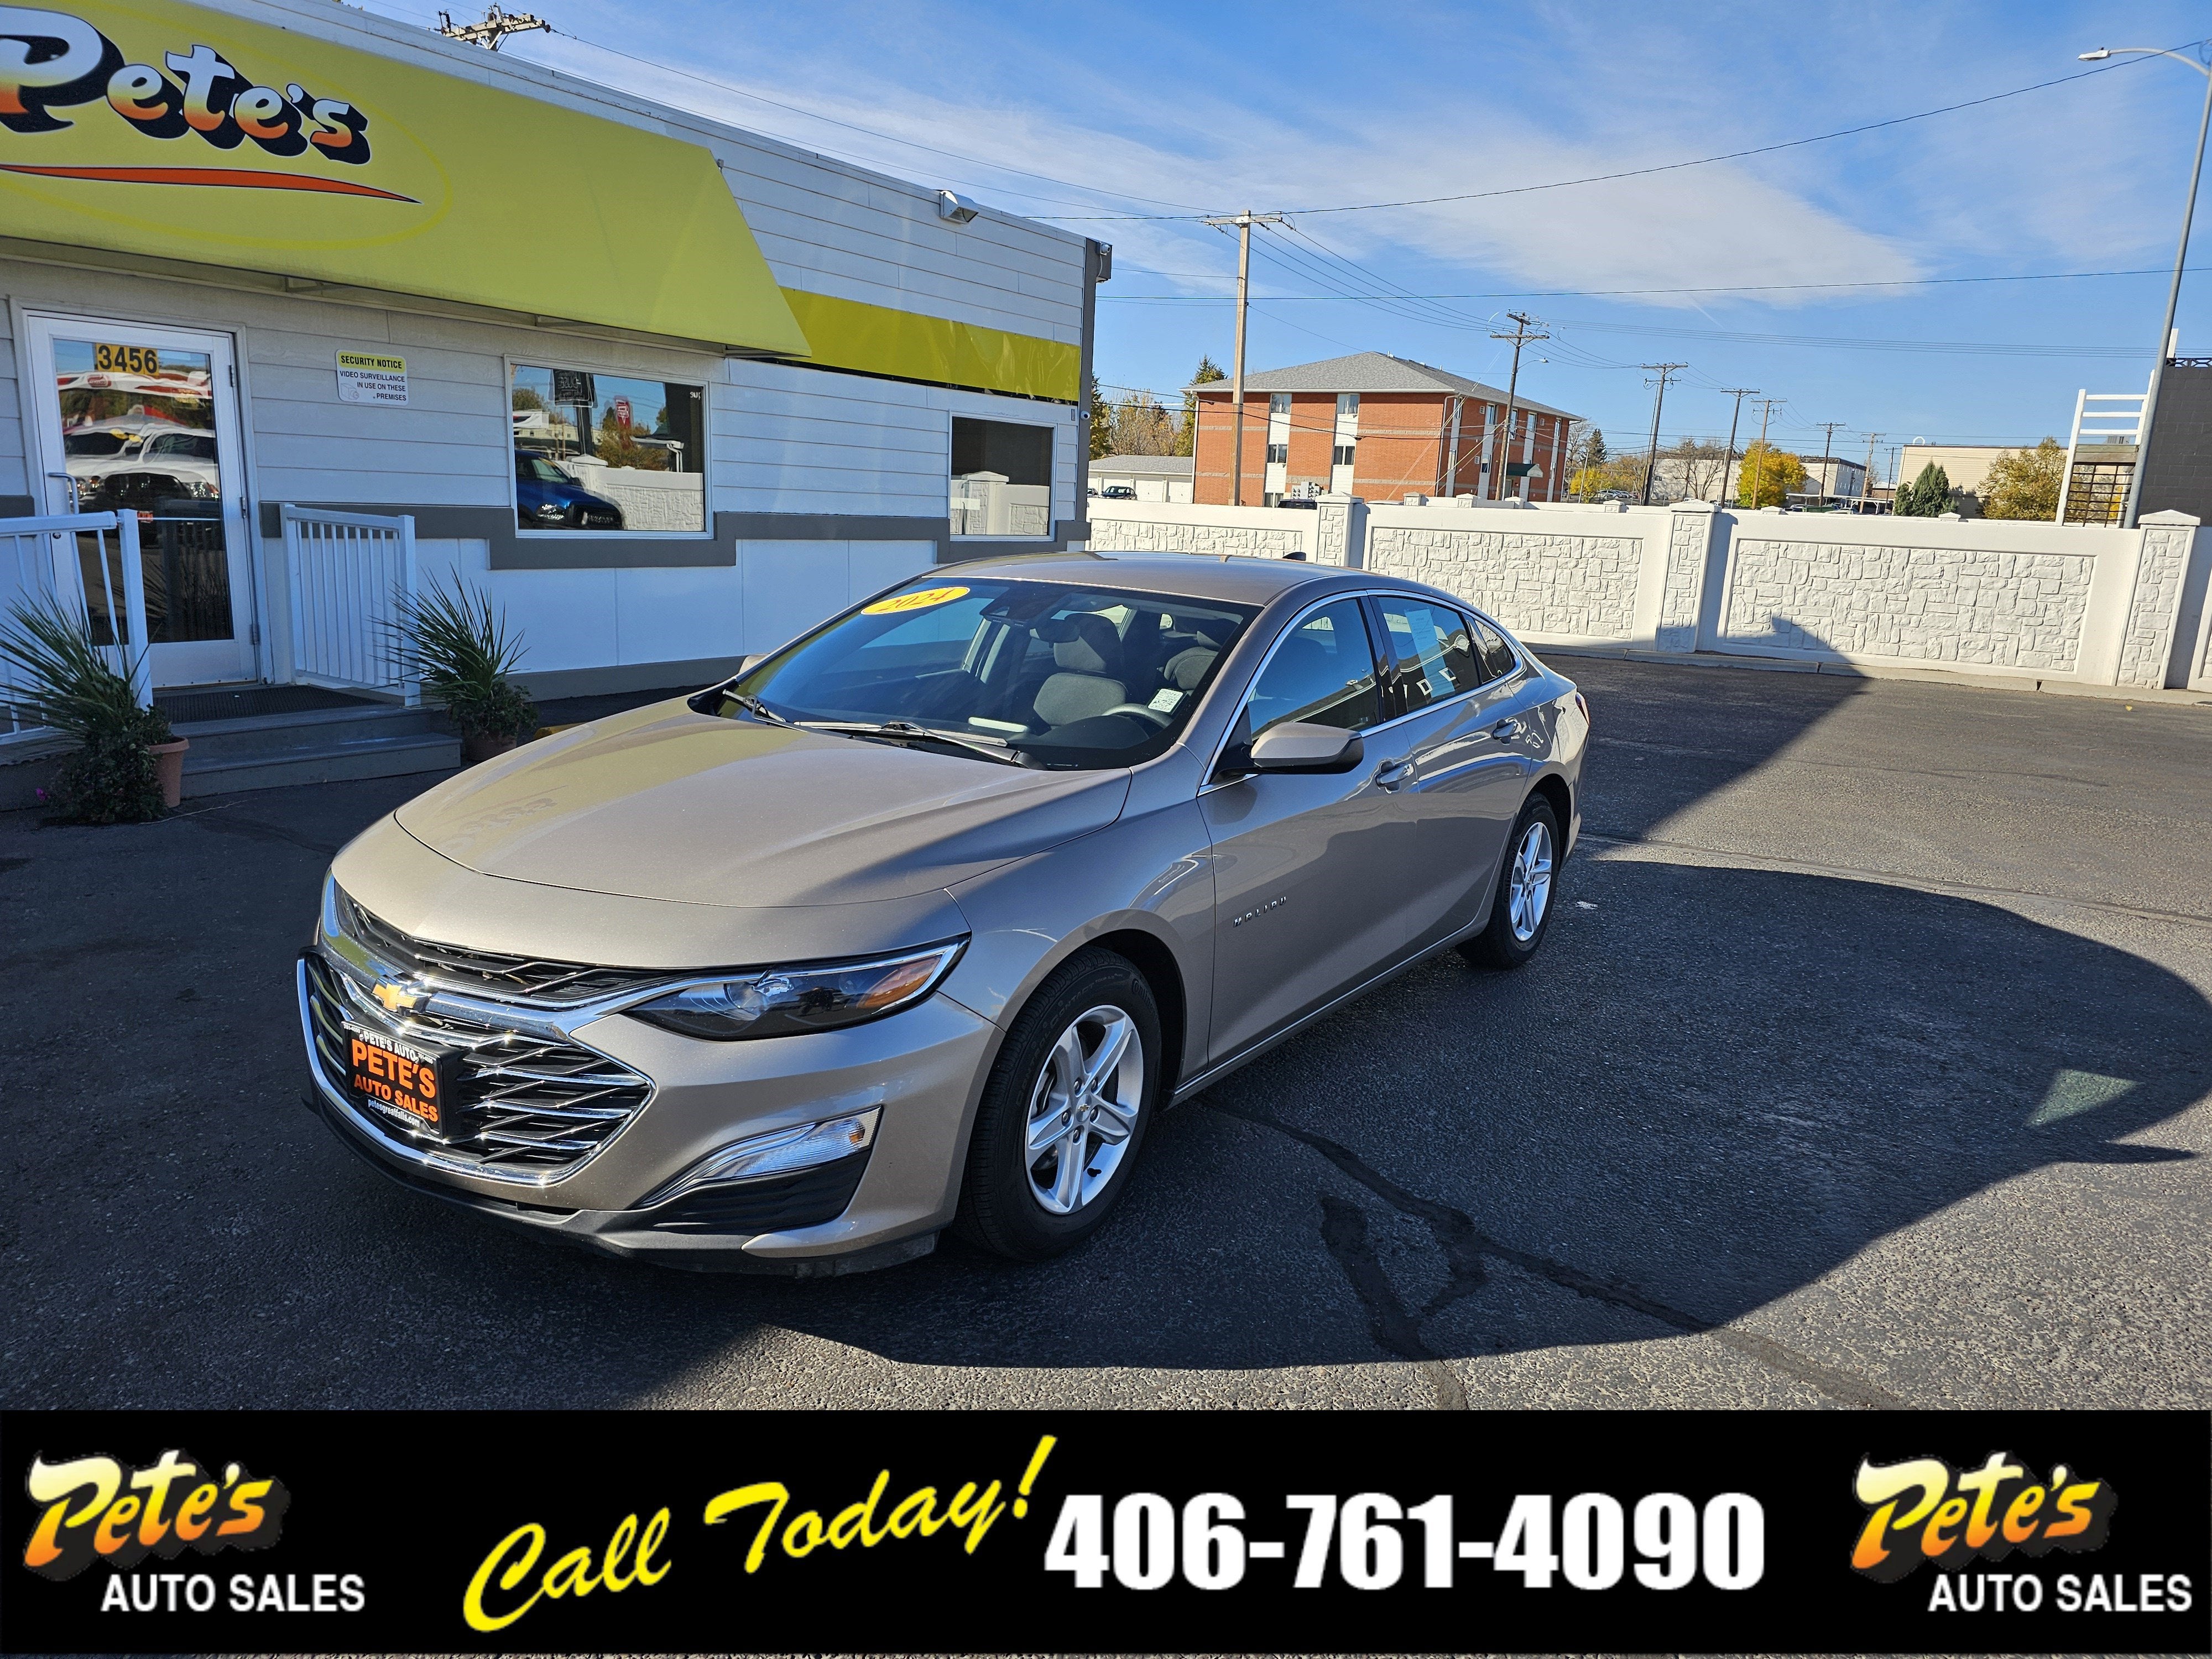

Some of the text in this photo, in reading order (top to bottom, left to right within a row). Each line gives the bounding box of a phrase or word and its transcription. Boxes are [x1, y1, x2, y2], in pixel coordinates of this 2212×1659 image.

[0, 6, 368, 161] Pete's
[98, 345, 157, 374] 3456
[341, 355, 402, 369] SECURITY NOTICE
[360, 372, 405, 382] SURVEILLANCE
[376, 393, 406, 401] PREMISES
[875, 588, 954, 612] 2024
[363, 1031, 415, 1062] PETE'S AUTO
[352, 1039, 435, 1098] PETE'S
[354, 1074, 439, 1122] AUTO SALES
